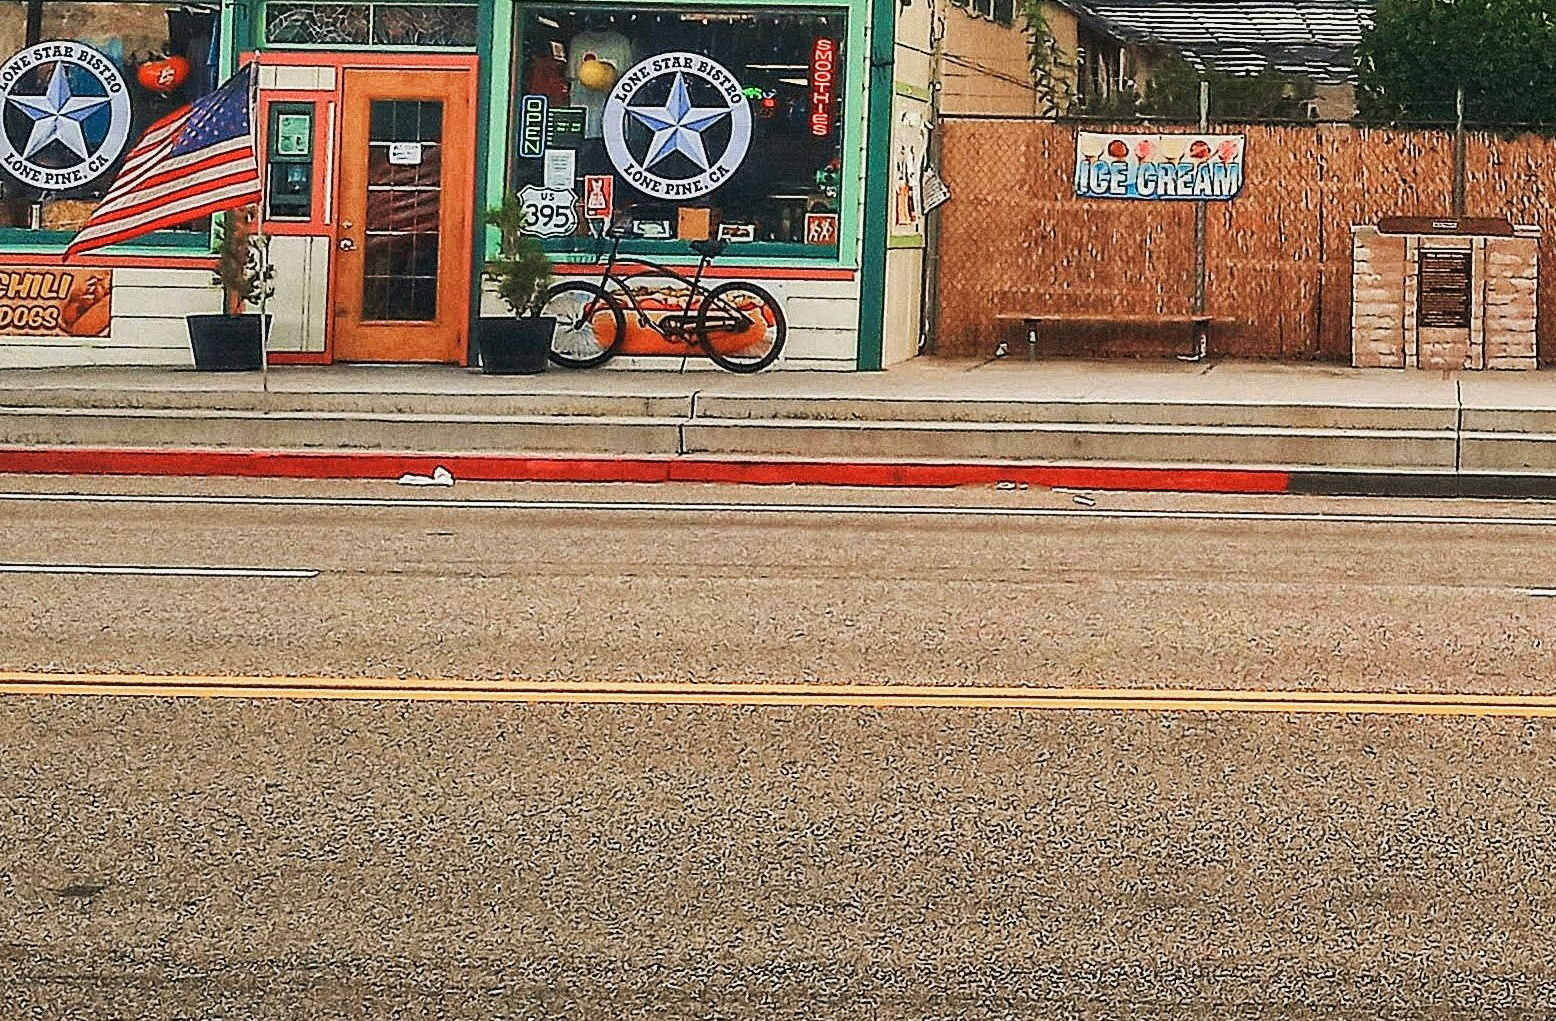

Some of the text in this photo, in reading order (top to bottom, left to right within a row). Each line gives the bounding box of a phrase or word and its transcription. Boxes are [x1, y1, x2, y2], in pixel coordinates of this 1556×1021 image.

[0, 45, 122, 94] LONE STAR BISTRO
[615, 56, 742, 104] LONE STAR BISTRO
[812, 39, 832, 135] SMOOTHIES
[524, 99, 542, 154] OPEN
[4, 152, 42, 182] LONE
[88, 154, 109, 173] CA
[624, 164, 660, 192] LONE
[709, 165, 730, 183] CA
[1078, 160, 1240, 196] ICE CREAM
[541, 192, 555, 201] US
[526, 203, 570, 228] 395
[0, 306, 59, 328] DOGS
